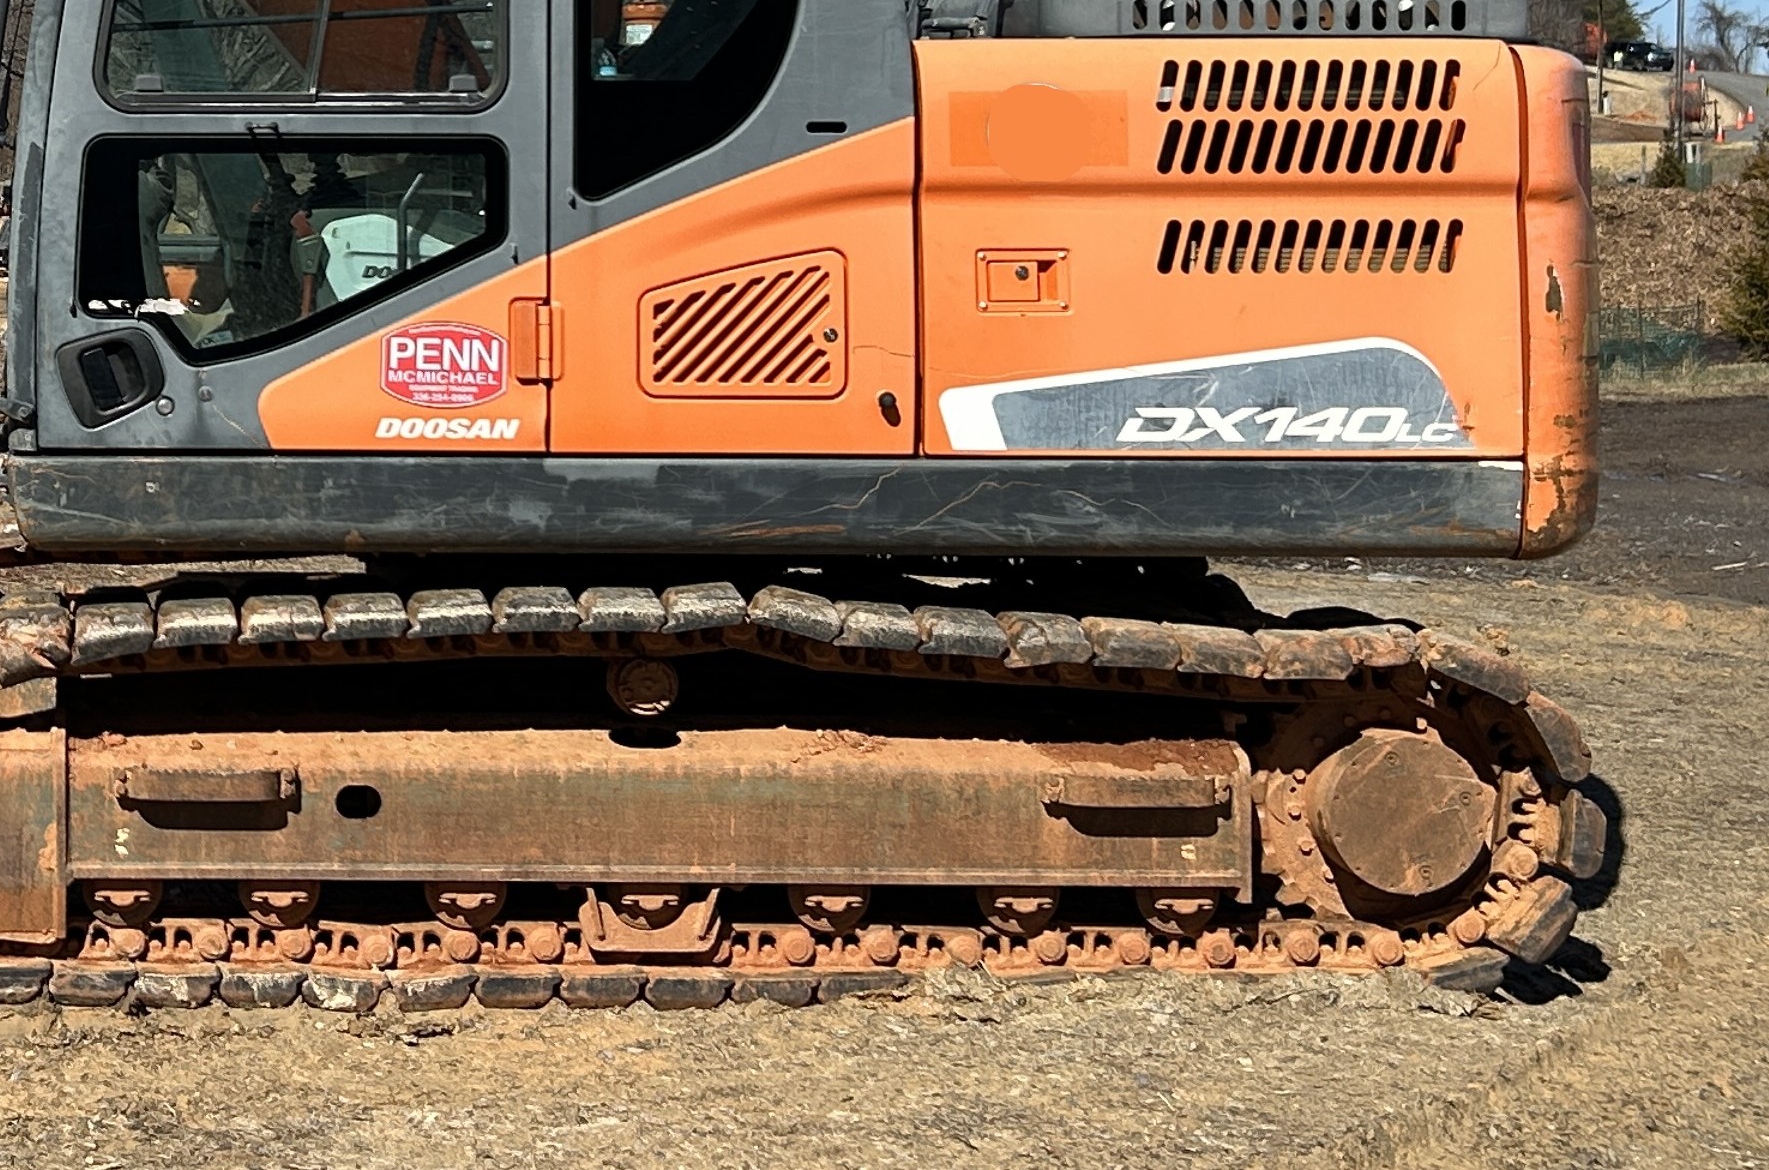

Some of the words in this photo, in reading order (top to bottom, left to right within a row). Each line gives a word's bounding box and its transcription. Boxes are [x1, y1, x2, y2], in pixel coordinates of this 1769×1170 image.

[388, 336, 500, 372] PENN
[387, 369, 499, 386] MCMICHAEL
[374, 417, 521, 440] DOOSAN
